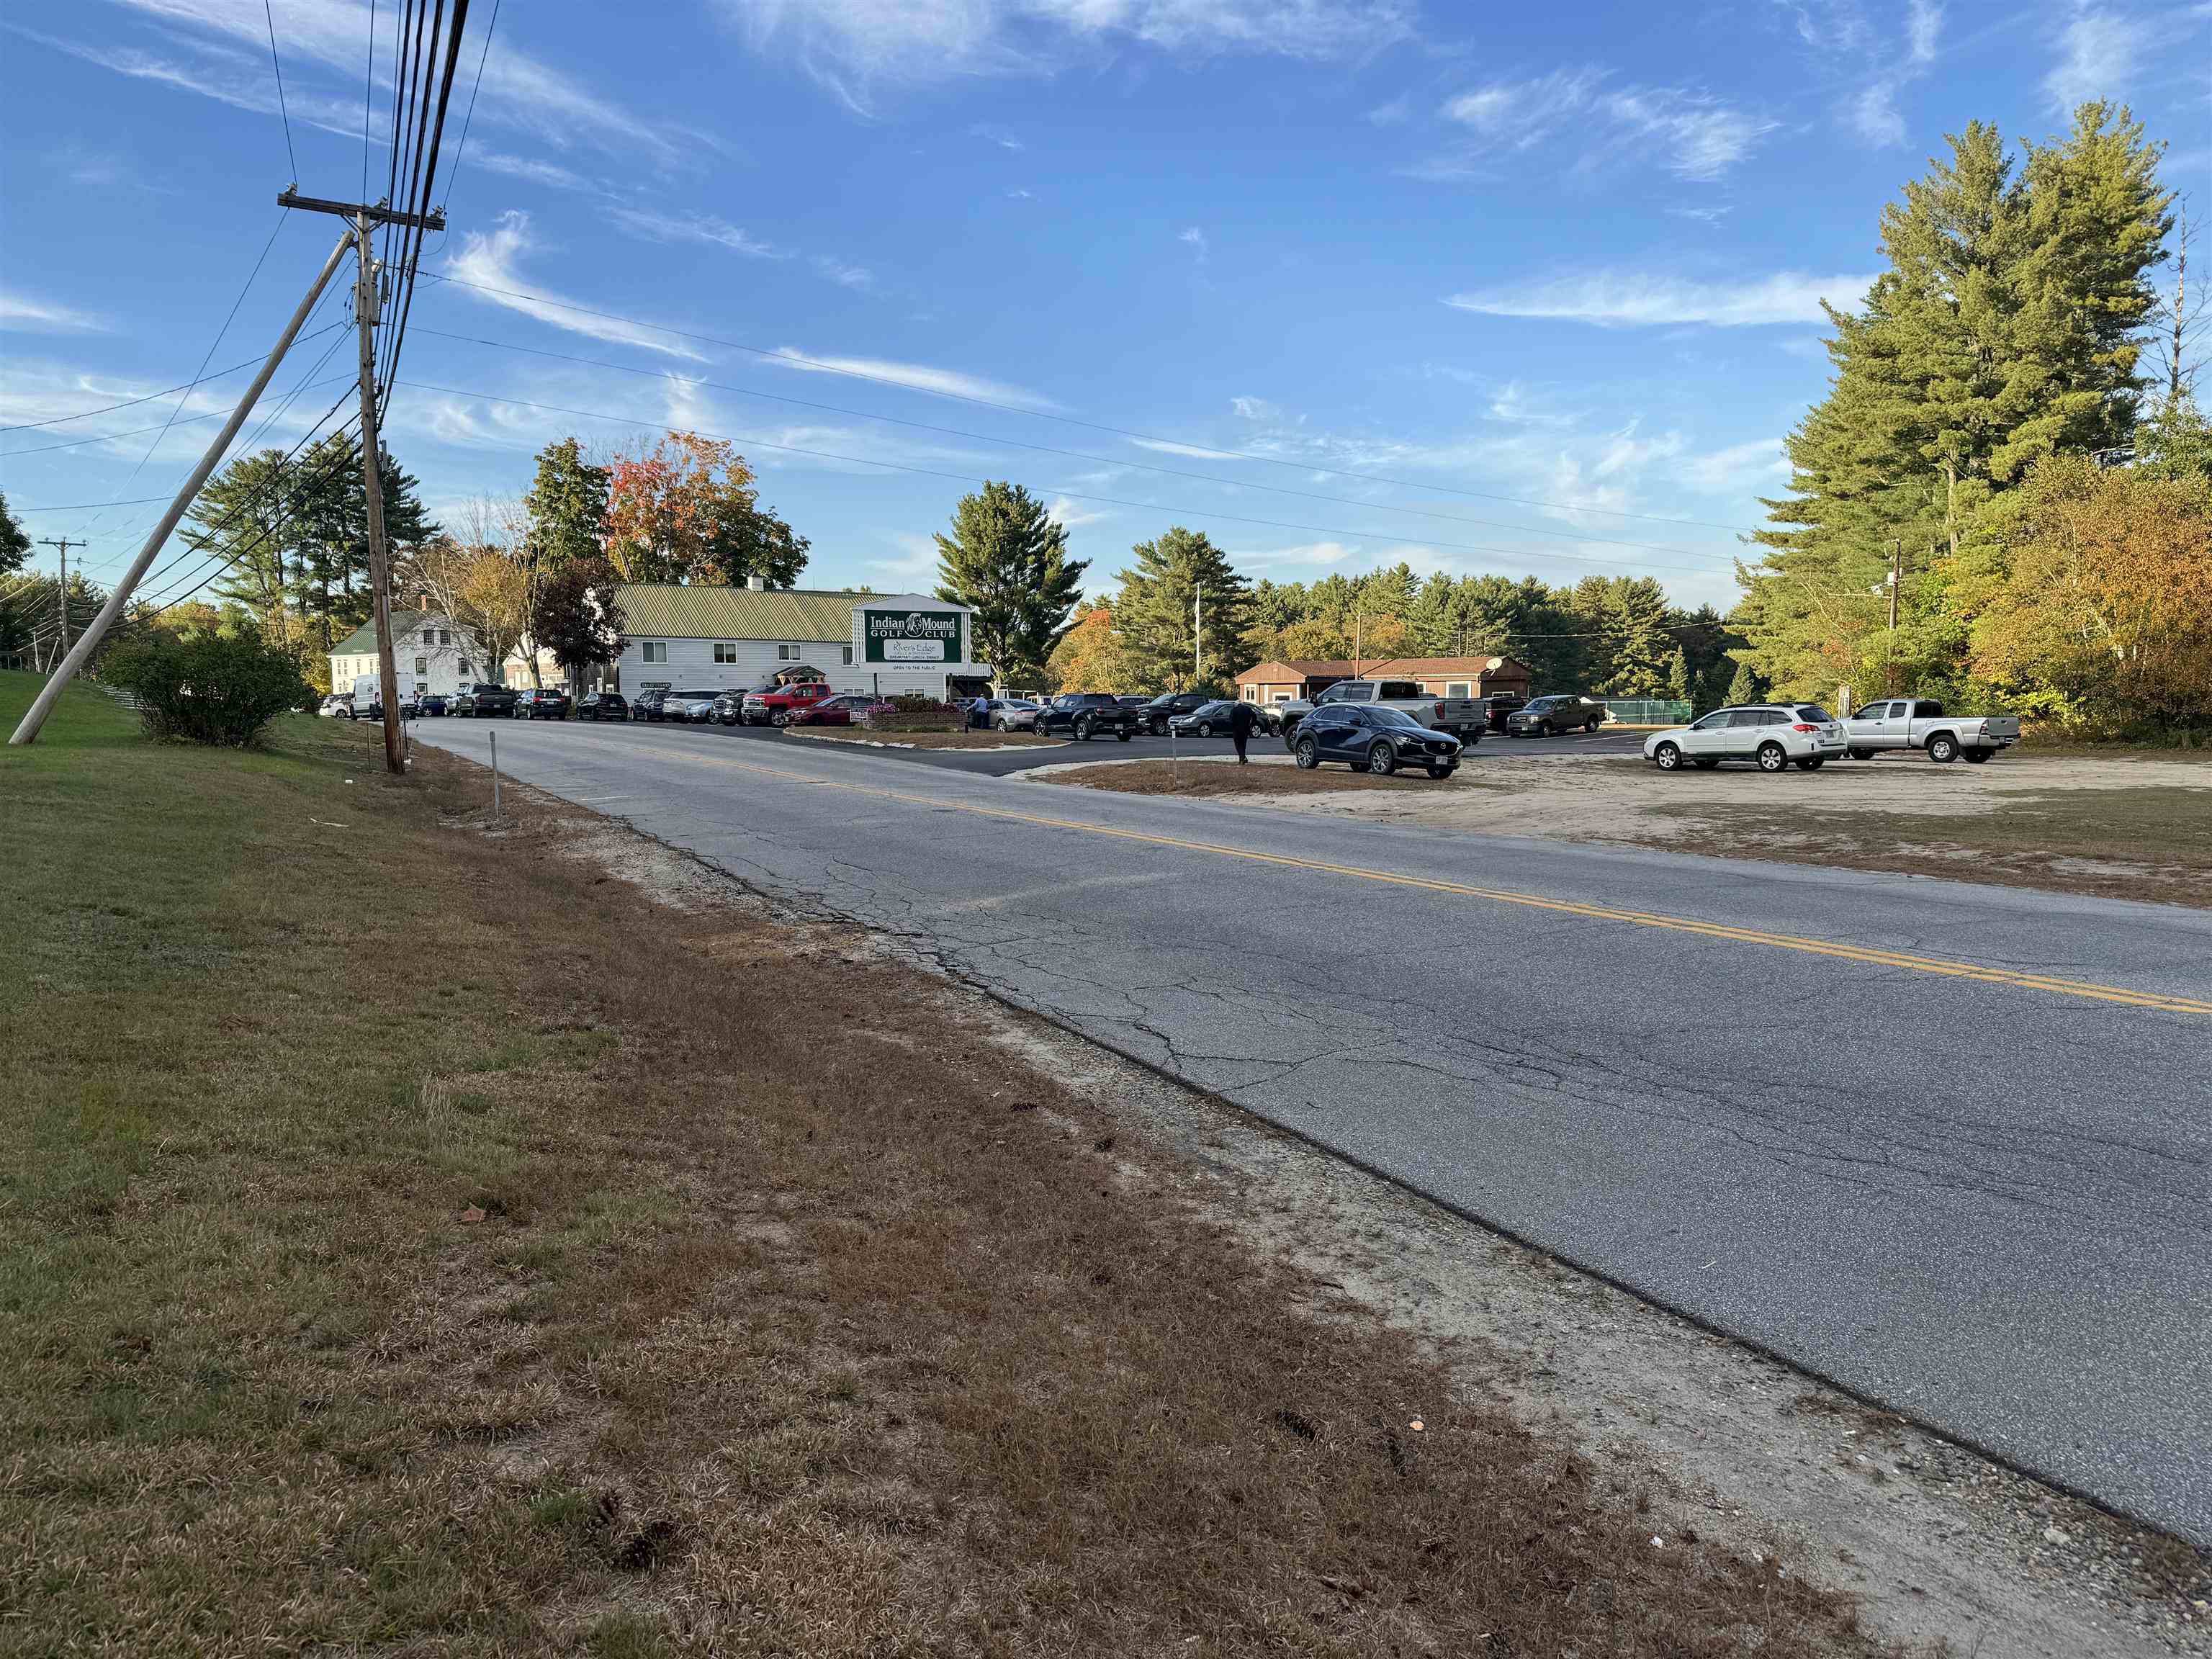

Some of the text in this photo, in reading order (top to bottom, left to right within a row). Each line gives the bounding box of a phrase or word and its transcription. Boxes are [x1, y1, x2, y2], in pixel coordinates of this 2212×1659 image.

[870, 616, 956, 629] Indian Mound
[917, 642, 935, 652] Edge
